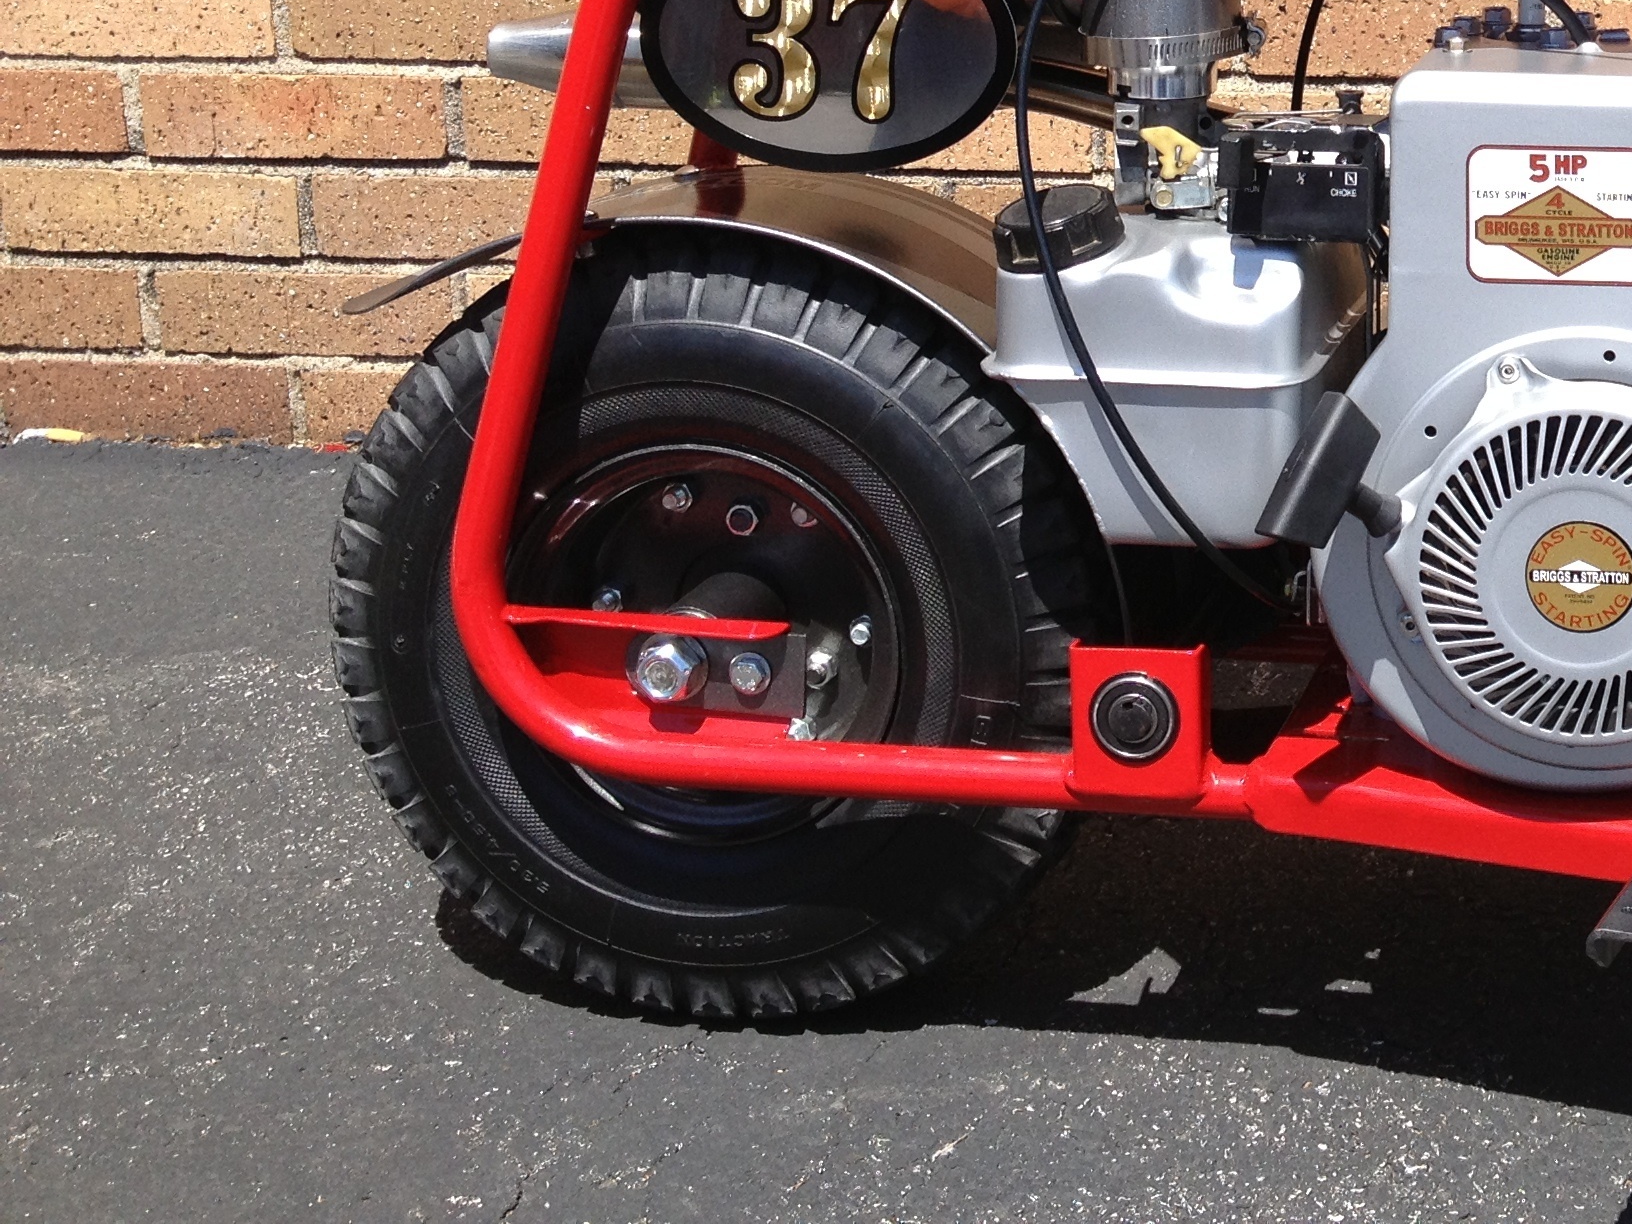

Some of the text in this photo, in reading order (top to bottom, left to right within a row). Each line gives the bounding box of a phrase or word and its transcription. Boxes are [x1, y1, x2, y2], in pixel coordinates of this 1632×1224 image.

[1529, 154, 1588, 183] 5 HP
[1329, 188, 1358, 198] CHOKE
[1545, 193, 1566, 210] 4
[1484, 221, 1540, 236] BRIGGS
[1544, 225, 1554, 237] &
[1536, 247, 1580, 255] GASOLINE
[1531, 526, 1631, 567] EASY-SPIN
[1532, 570, 1630, 585] BRIGGS & STRATTON
[1533, 592, 1630, 628] STARTING
